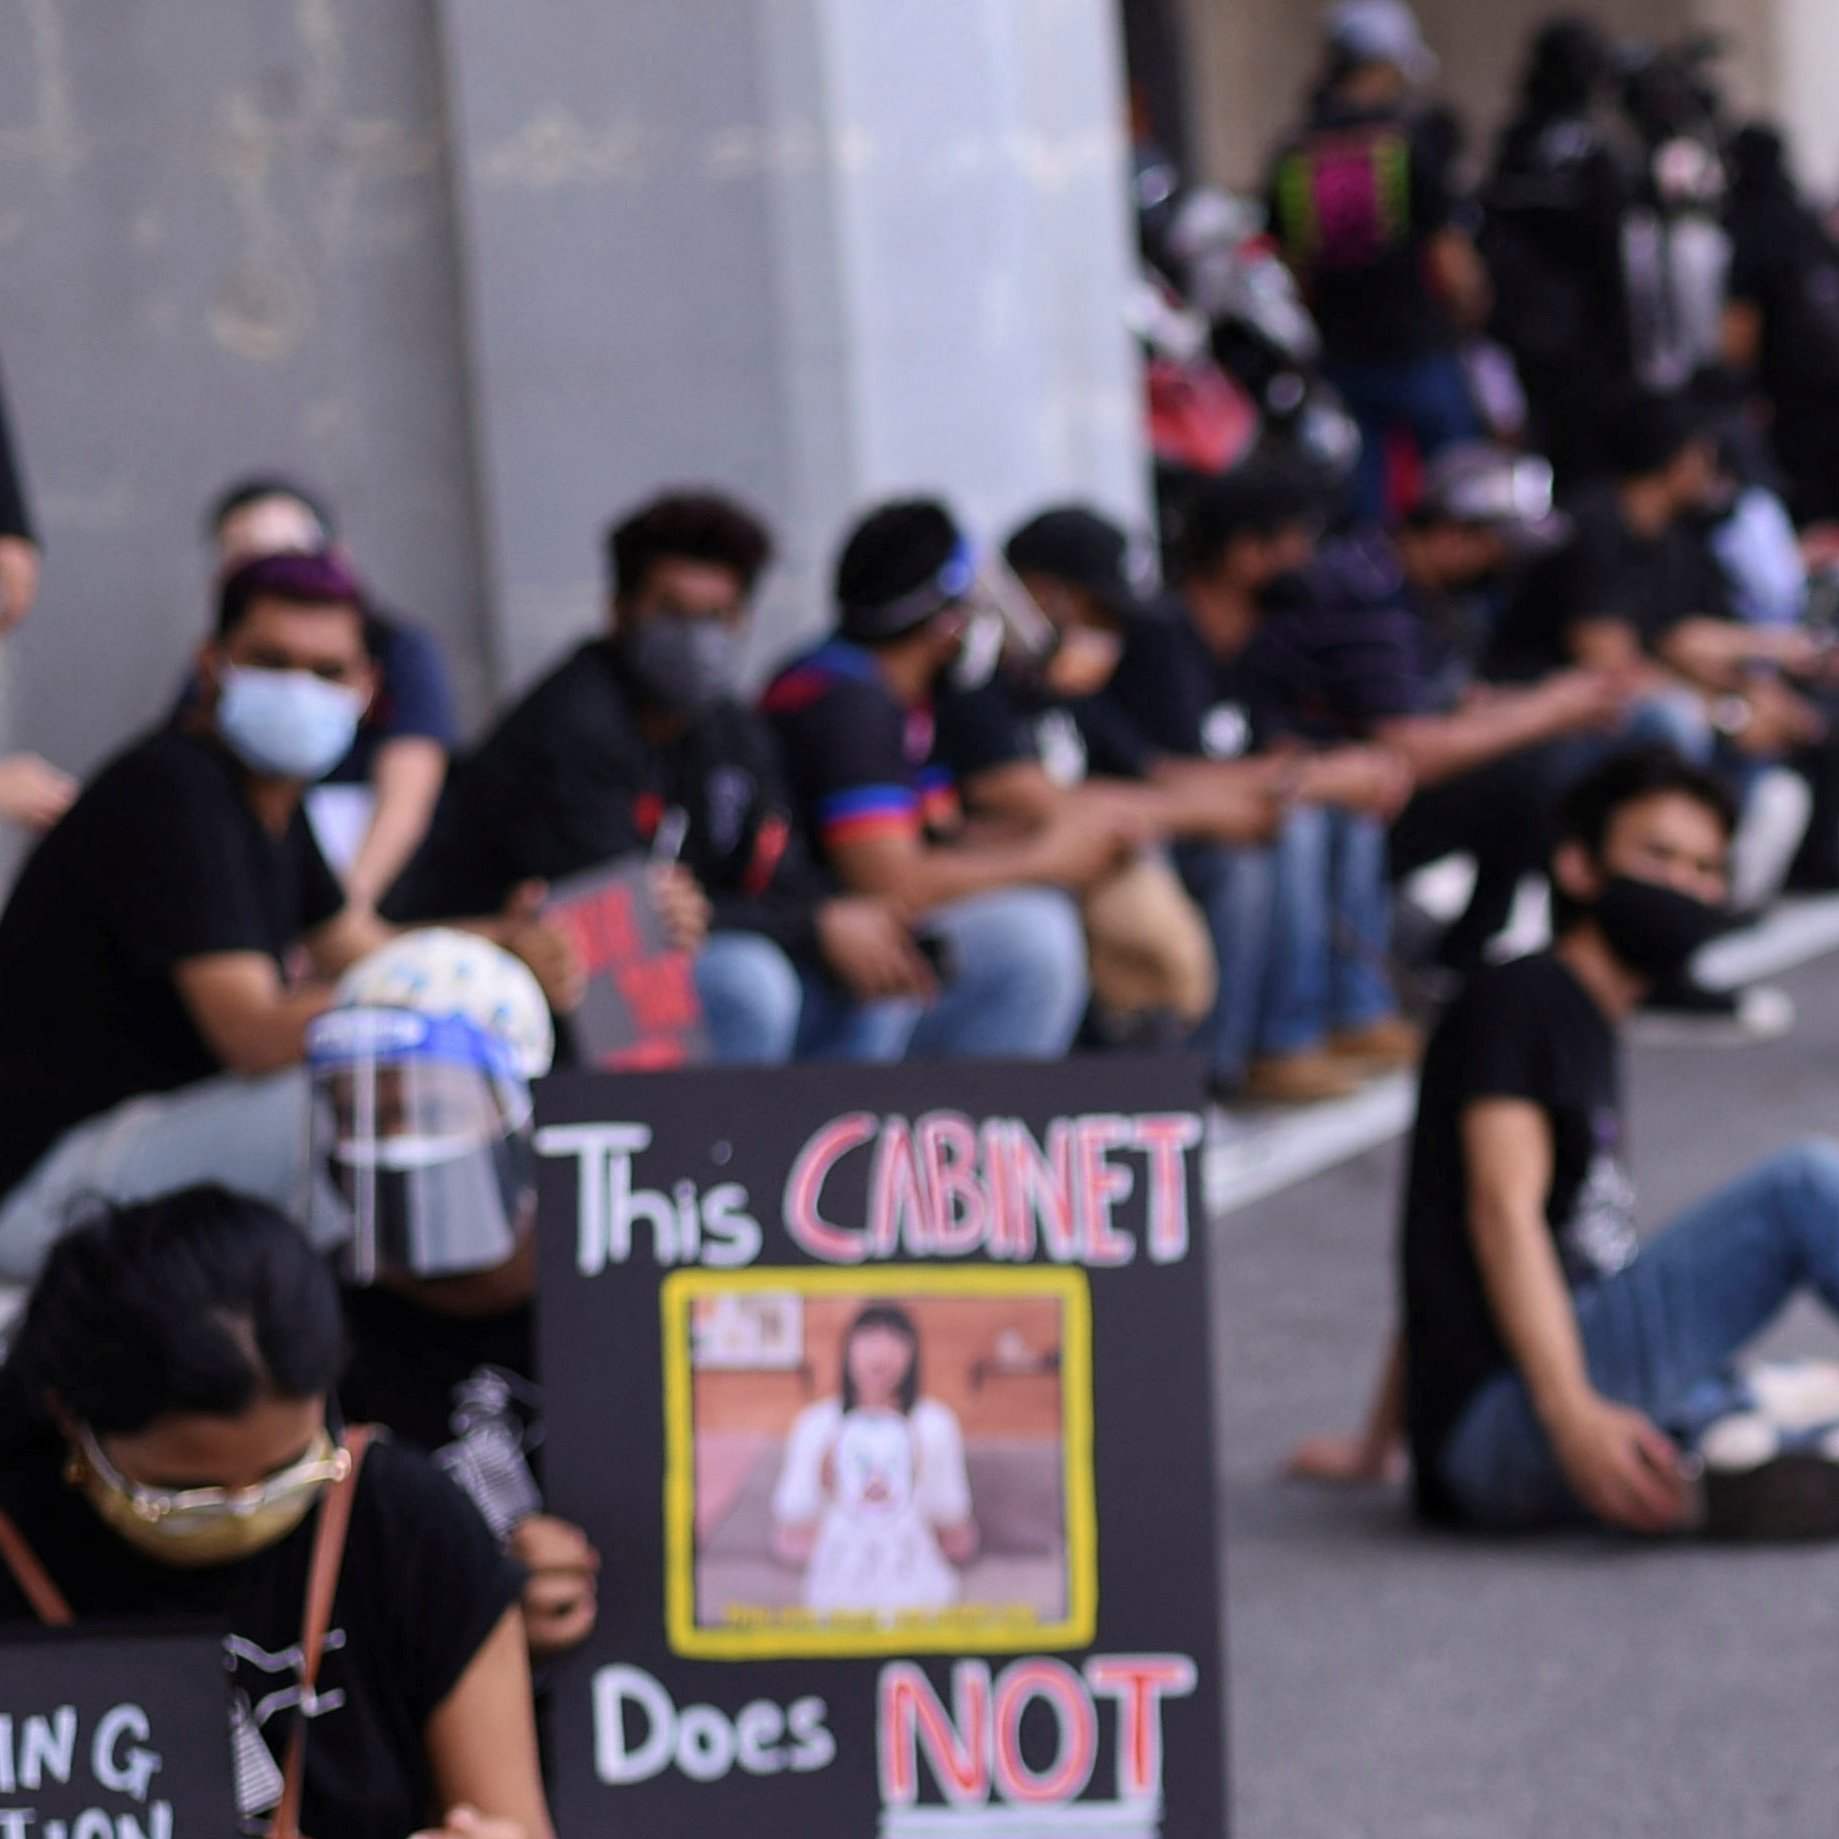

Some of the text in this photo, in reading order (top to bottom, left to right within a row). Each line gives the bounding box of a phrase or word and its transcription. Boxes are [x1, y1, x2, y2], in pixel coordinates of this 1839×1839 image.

[534, 1108, 1199, 1275] This CABINET
[593, 1655, 1197, 1808] Does NOT
